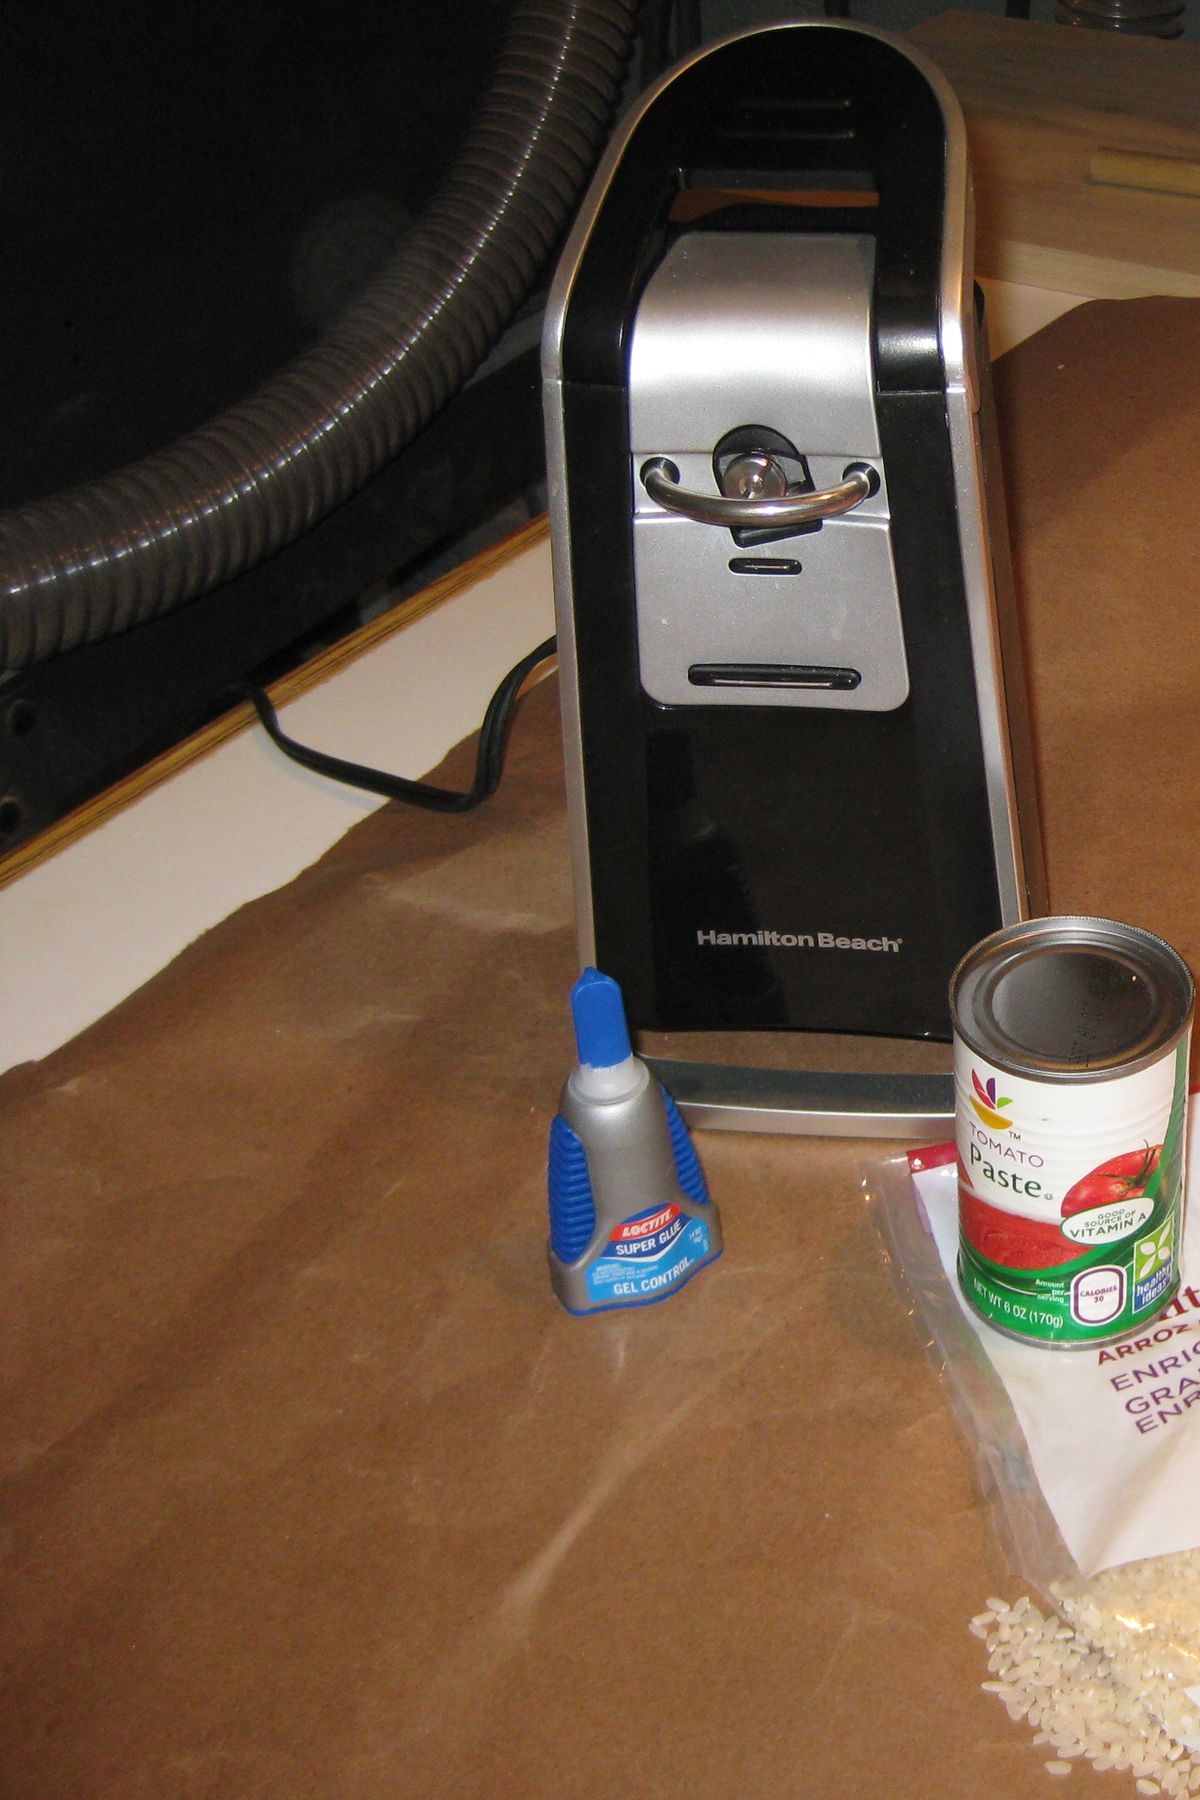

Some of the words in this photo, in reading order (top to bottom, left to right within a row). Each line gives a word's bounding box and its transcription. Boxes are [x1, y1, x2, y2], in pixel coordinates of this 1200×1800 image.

[697, 930, 814, 947] Hamilton
[817, 932, 899, 952] Beach
[969, 1121, 1044, 1168] TOMATO
[970, 1141, 1042, 1198] Paste
[622, 1207, 672, 1237] LOCTITE
[1070, 1219, 1133, 1238] VITAMIN
[1137, 1212, 1147, 1223] A
[1084, 1216, 1123, 1228] SOURCE
[1125, 1210, 1136, 1219] OF
[1097, 1208, 1125, 1219] GOOD
[615, 1238, 656, 1256] SUPER
[658, 1218, 682, 1245] GLUE
[613, 1282, 638, 1295] GEL
[640, 1256, 692, 1292] CONTROL
[1035, 1278, 1065, 1289] Amount
[1136, 1265, 1170, 1296] healthy
[973, 1277, 987, 1299] NET
[988, 1291, 1003, 1308] WT
[1003, 1301, 1011, 1313] 6
[1012, 1305, 1027, 1320] OZ
[1028, 1310, 1064, 1328] (170g)
[1051, 1289, 1065, 1297] per
[1080, 1285, 1118, 1297] CALORIES
[1098, 1323, 1193, 1365] ARROZ
